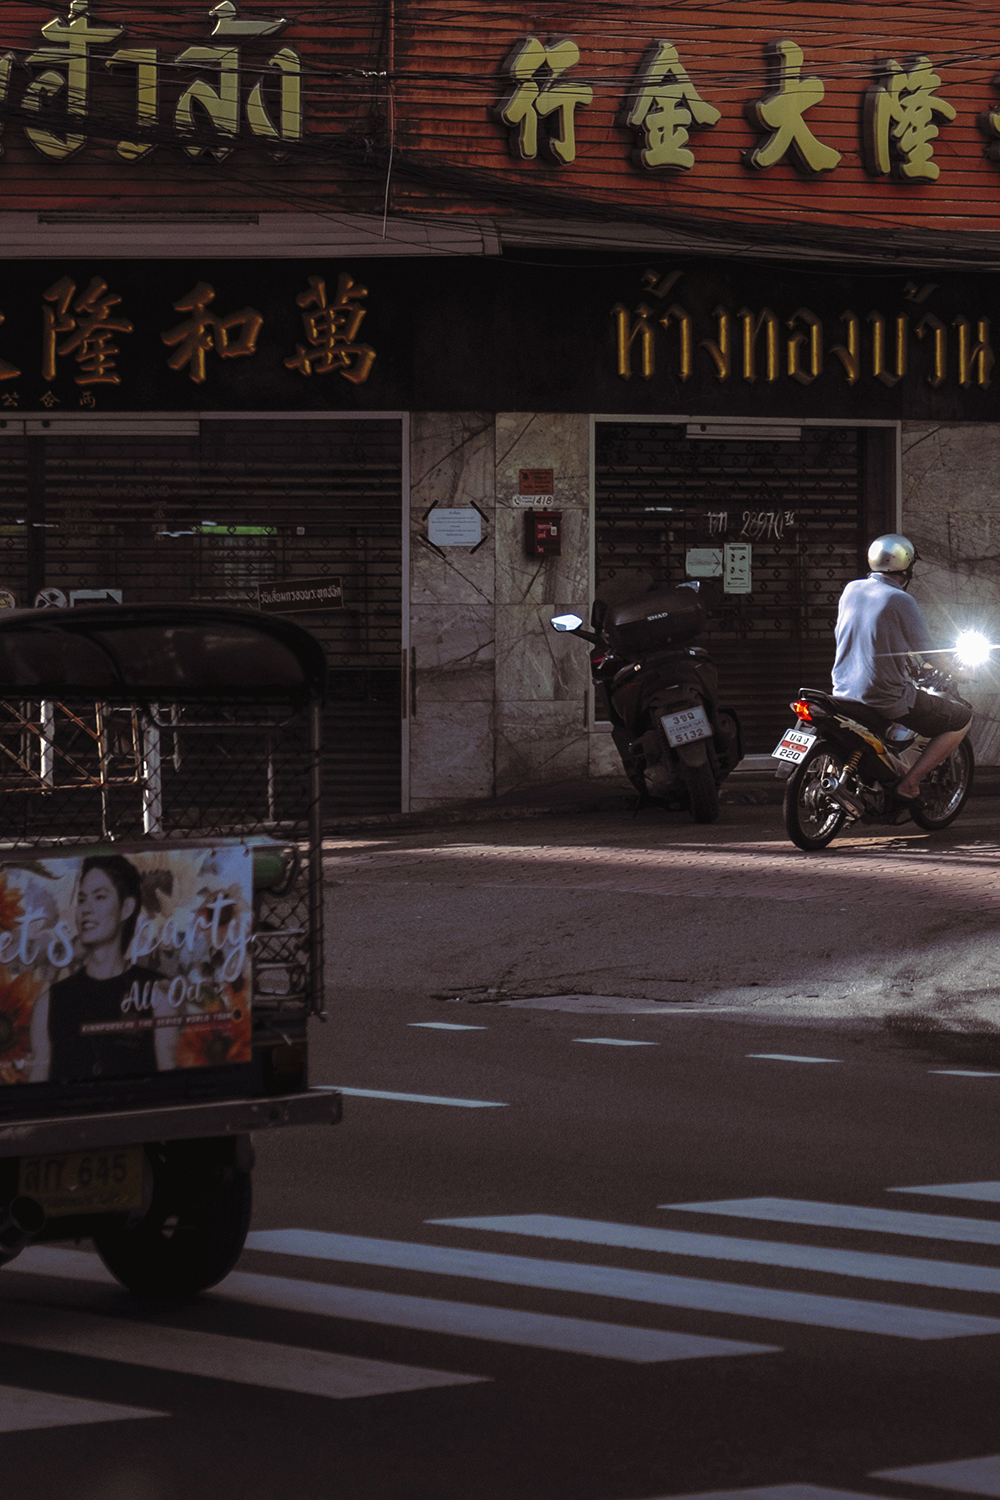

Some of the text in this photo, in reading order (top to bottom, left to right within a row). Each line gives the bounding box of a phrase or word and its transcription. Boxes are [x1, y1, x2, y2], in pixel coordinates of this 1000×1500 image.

[675, 728, 704, 743] 5132
[779, 749, 801, 761] 220
[130, 892, 254, 985] party
[121, 979, 157, 1014] All
